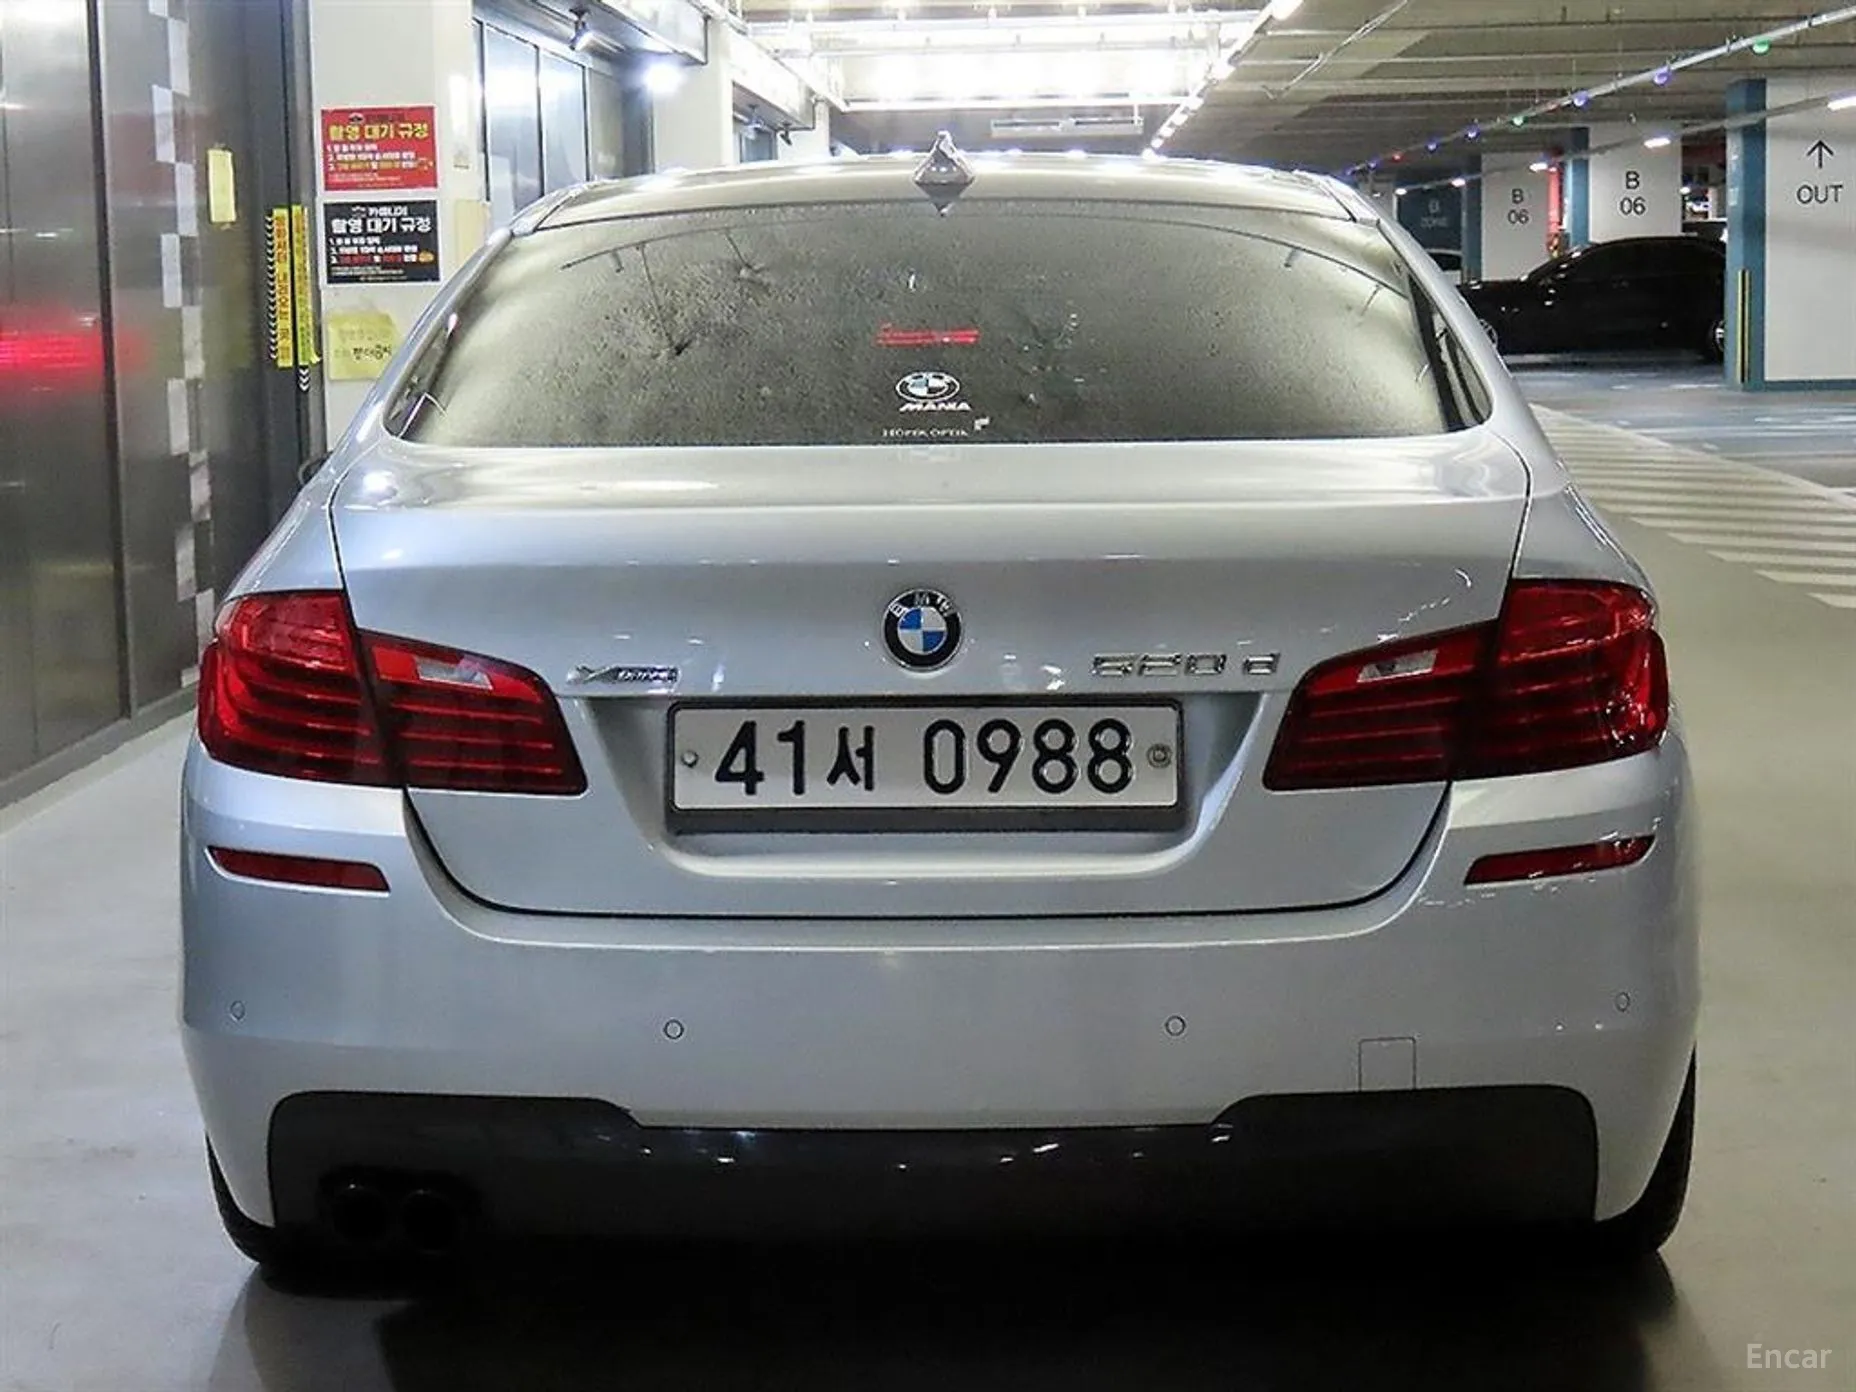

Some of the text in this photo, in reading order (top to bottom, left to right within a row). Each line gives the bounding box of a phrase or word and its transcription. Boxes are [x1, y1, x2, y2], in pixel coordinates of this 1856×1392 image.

[398, 121, 429, 139] 규정
[1626, 170, 1640, 189] B
[1511, 188, 1524, 204] B
[1797, 184, 1843, 204] OUT
[1620, 197, 1646, 216] 06
[366, 217, 397, 233] 대기
[401, 216, 432, 233] 규정
[1507, 209, 1529, 225] 06
[888, 590, 960, 618] BMW
[922, 717, 1134, 795] 0988
